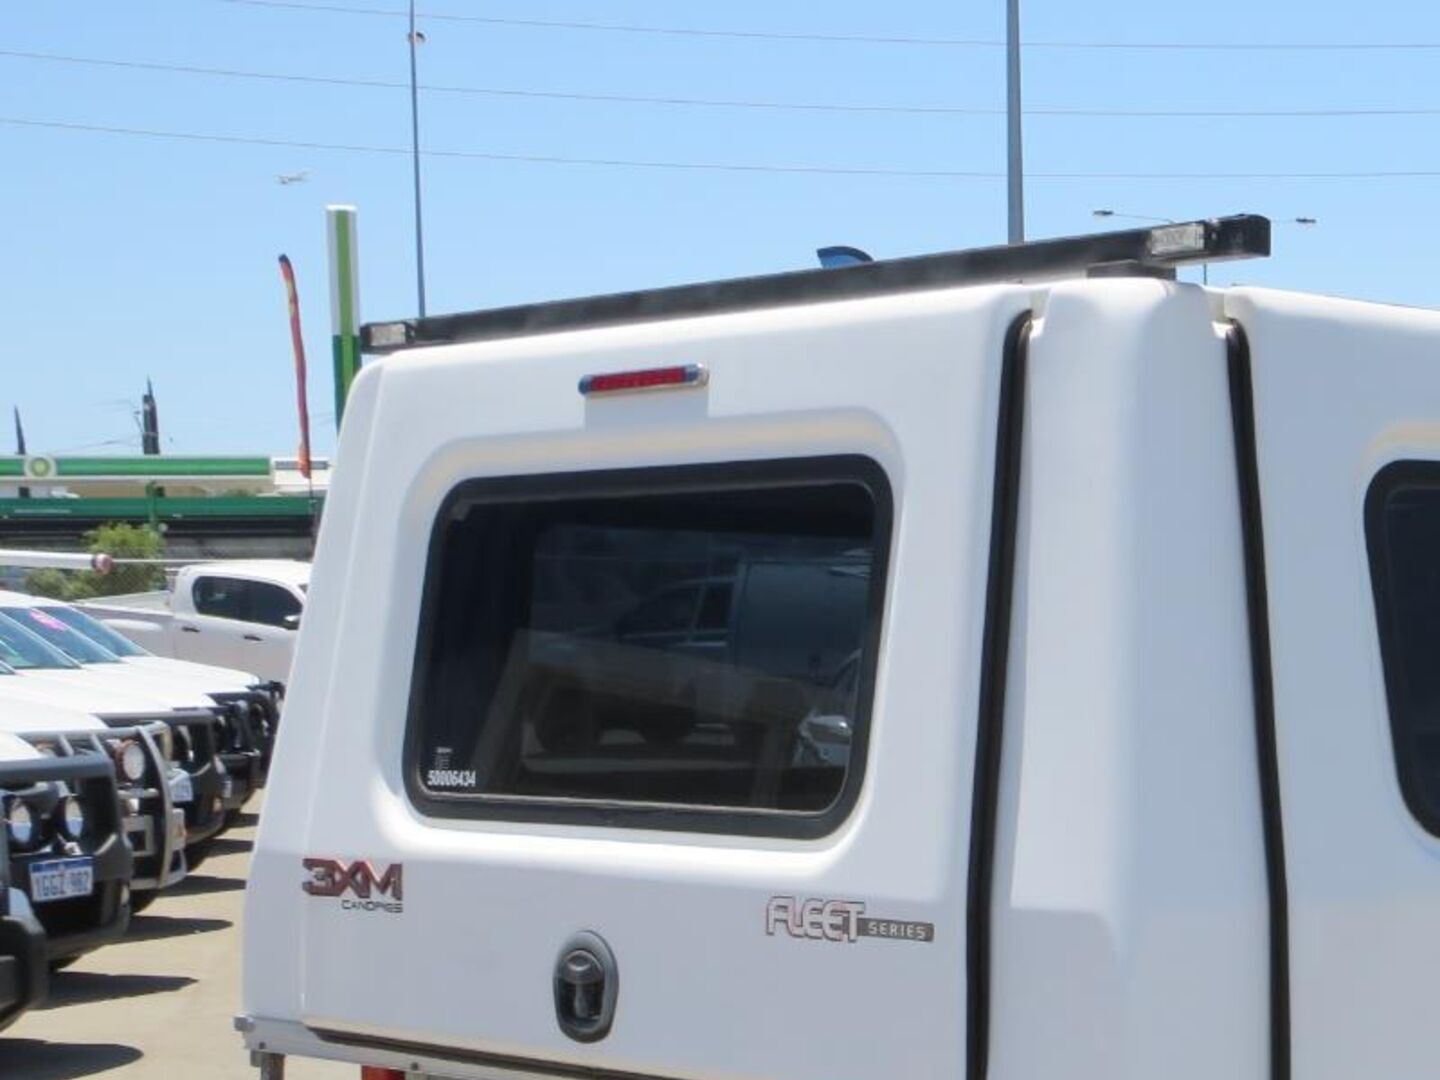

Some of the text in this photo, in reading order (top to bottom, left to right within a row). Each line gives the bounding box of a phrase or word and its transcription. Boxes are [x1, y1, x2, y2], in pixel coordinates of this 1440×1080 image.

[301, 858, 404, 902] 3XM
[765, 895, 926, 943] FLEET SERIES
